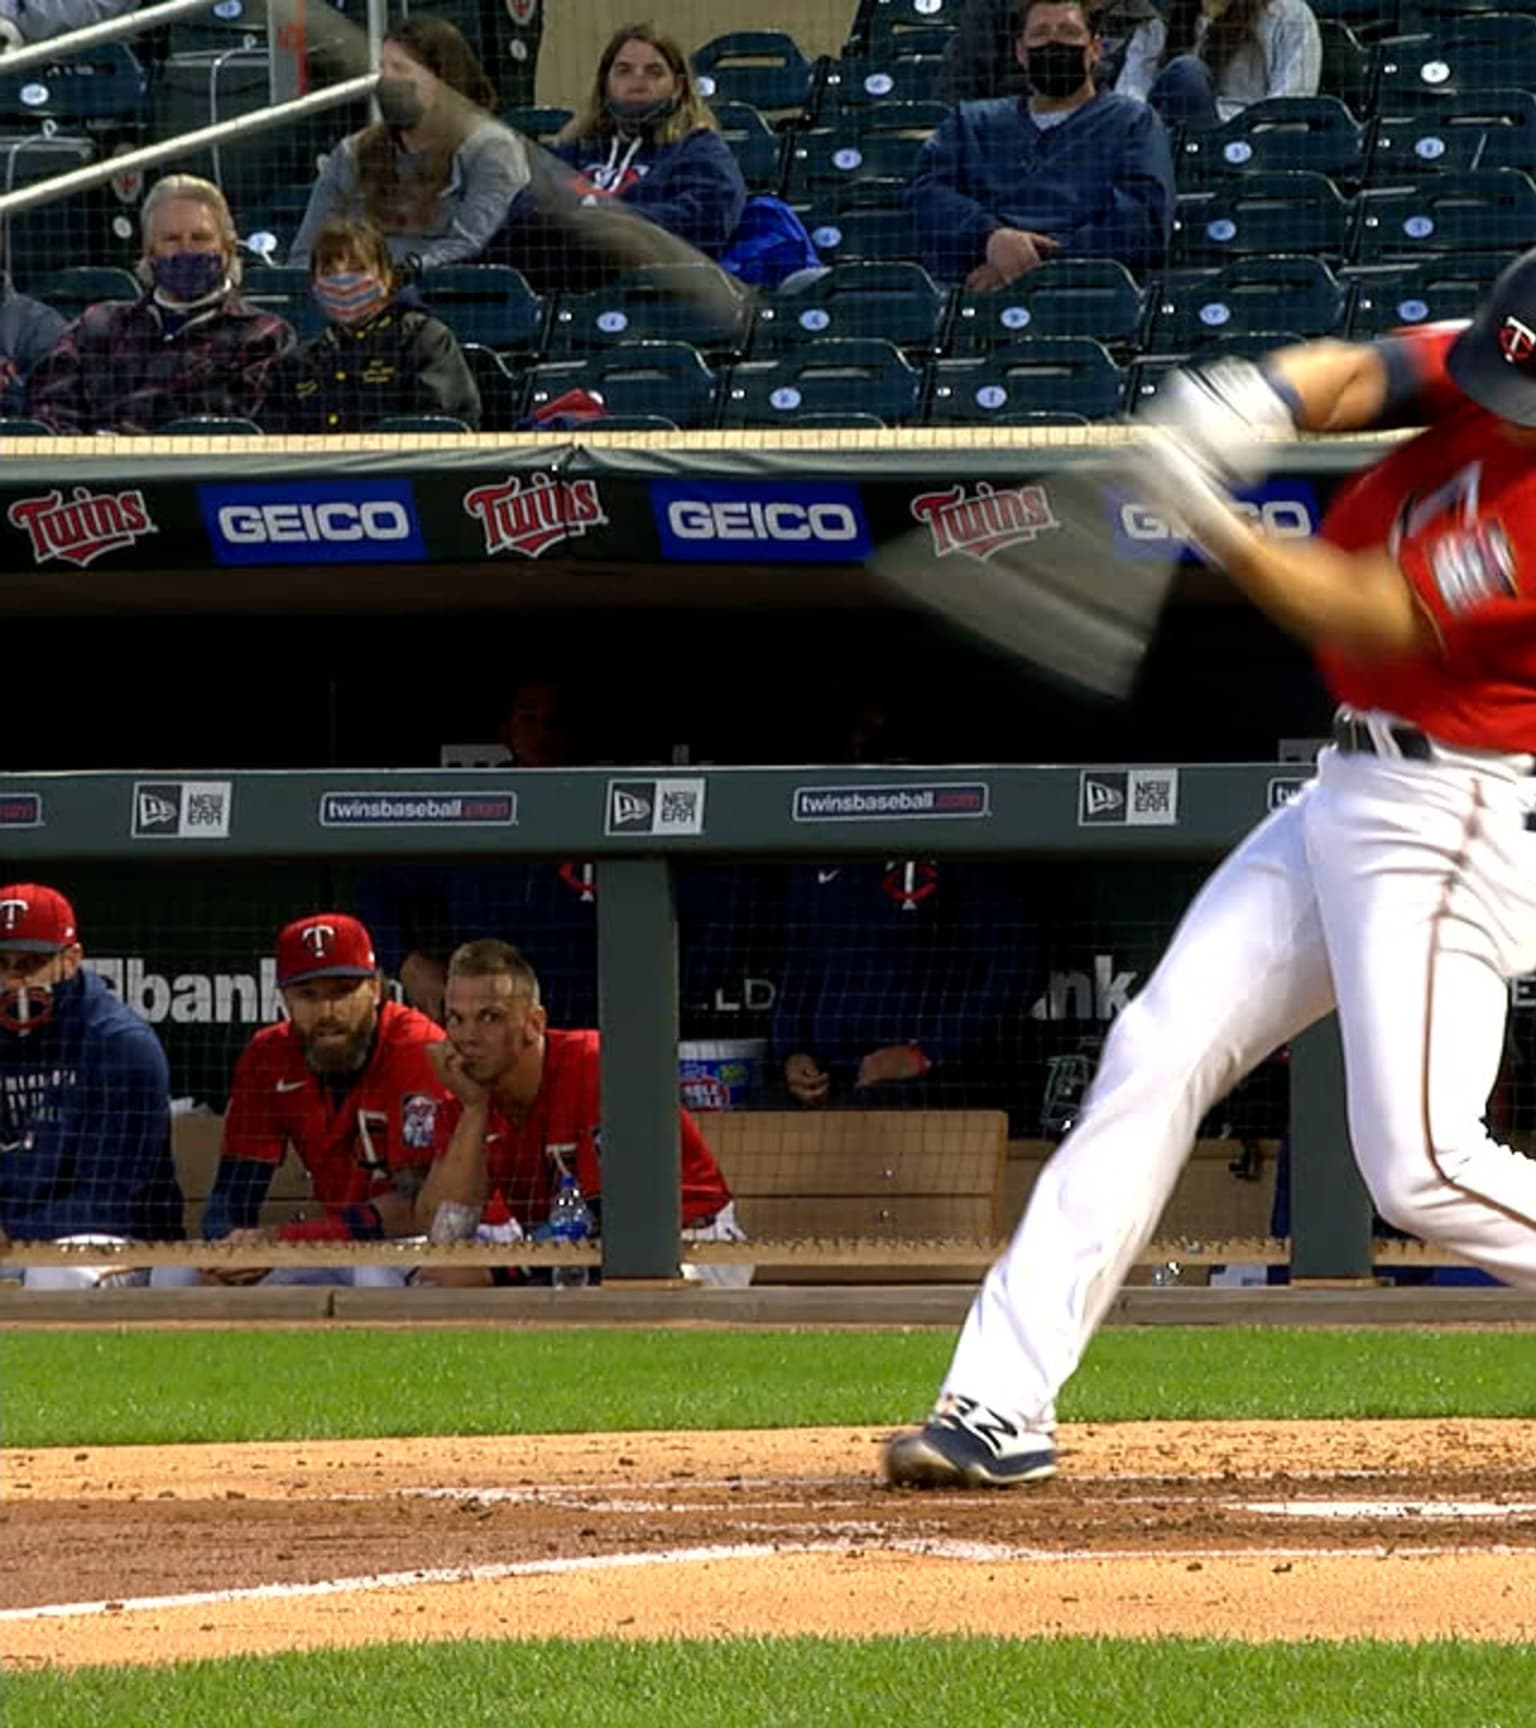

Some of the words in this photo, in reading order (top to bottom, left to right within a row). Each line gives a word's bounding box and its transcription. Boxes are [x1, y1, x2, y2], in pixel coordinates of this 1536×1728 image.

[218, 502, 409, 543] GEICO
[463, 472, 607, 558] Twins
[668, 501, 857, 541] GEICO
[910, 482, 1060, 561] Twins
[8, 486, 158, 567] Twins
[662, 790, 698, 807] NEW
[1134, 782, 1168, 799] NEW
[188, 793, 224, 810] NEW
[1134, 796, 1168, 813] ERA
[187, 809, 223, 826] ERA
[661, 806, 698, 823] ERA
